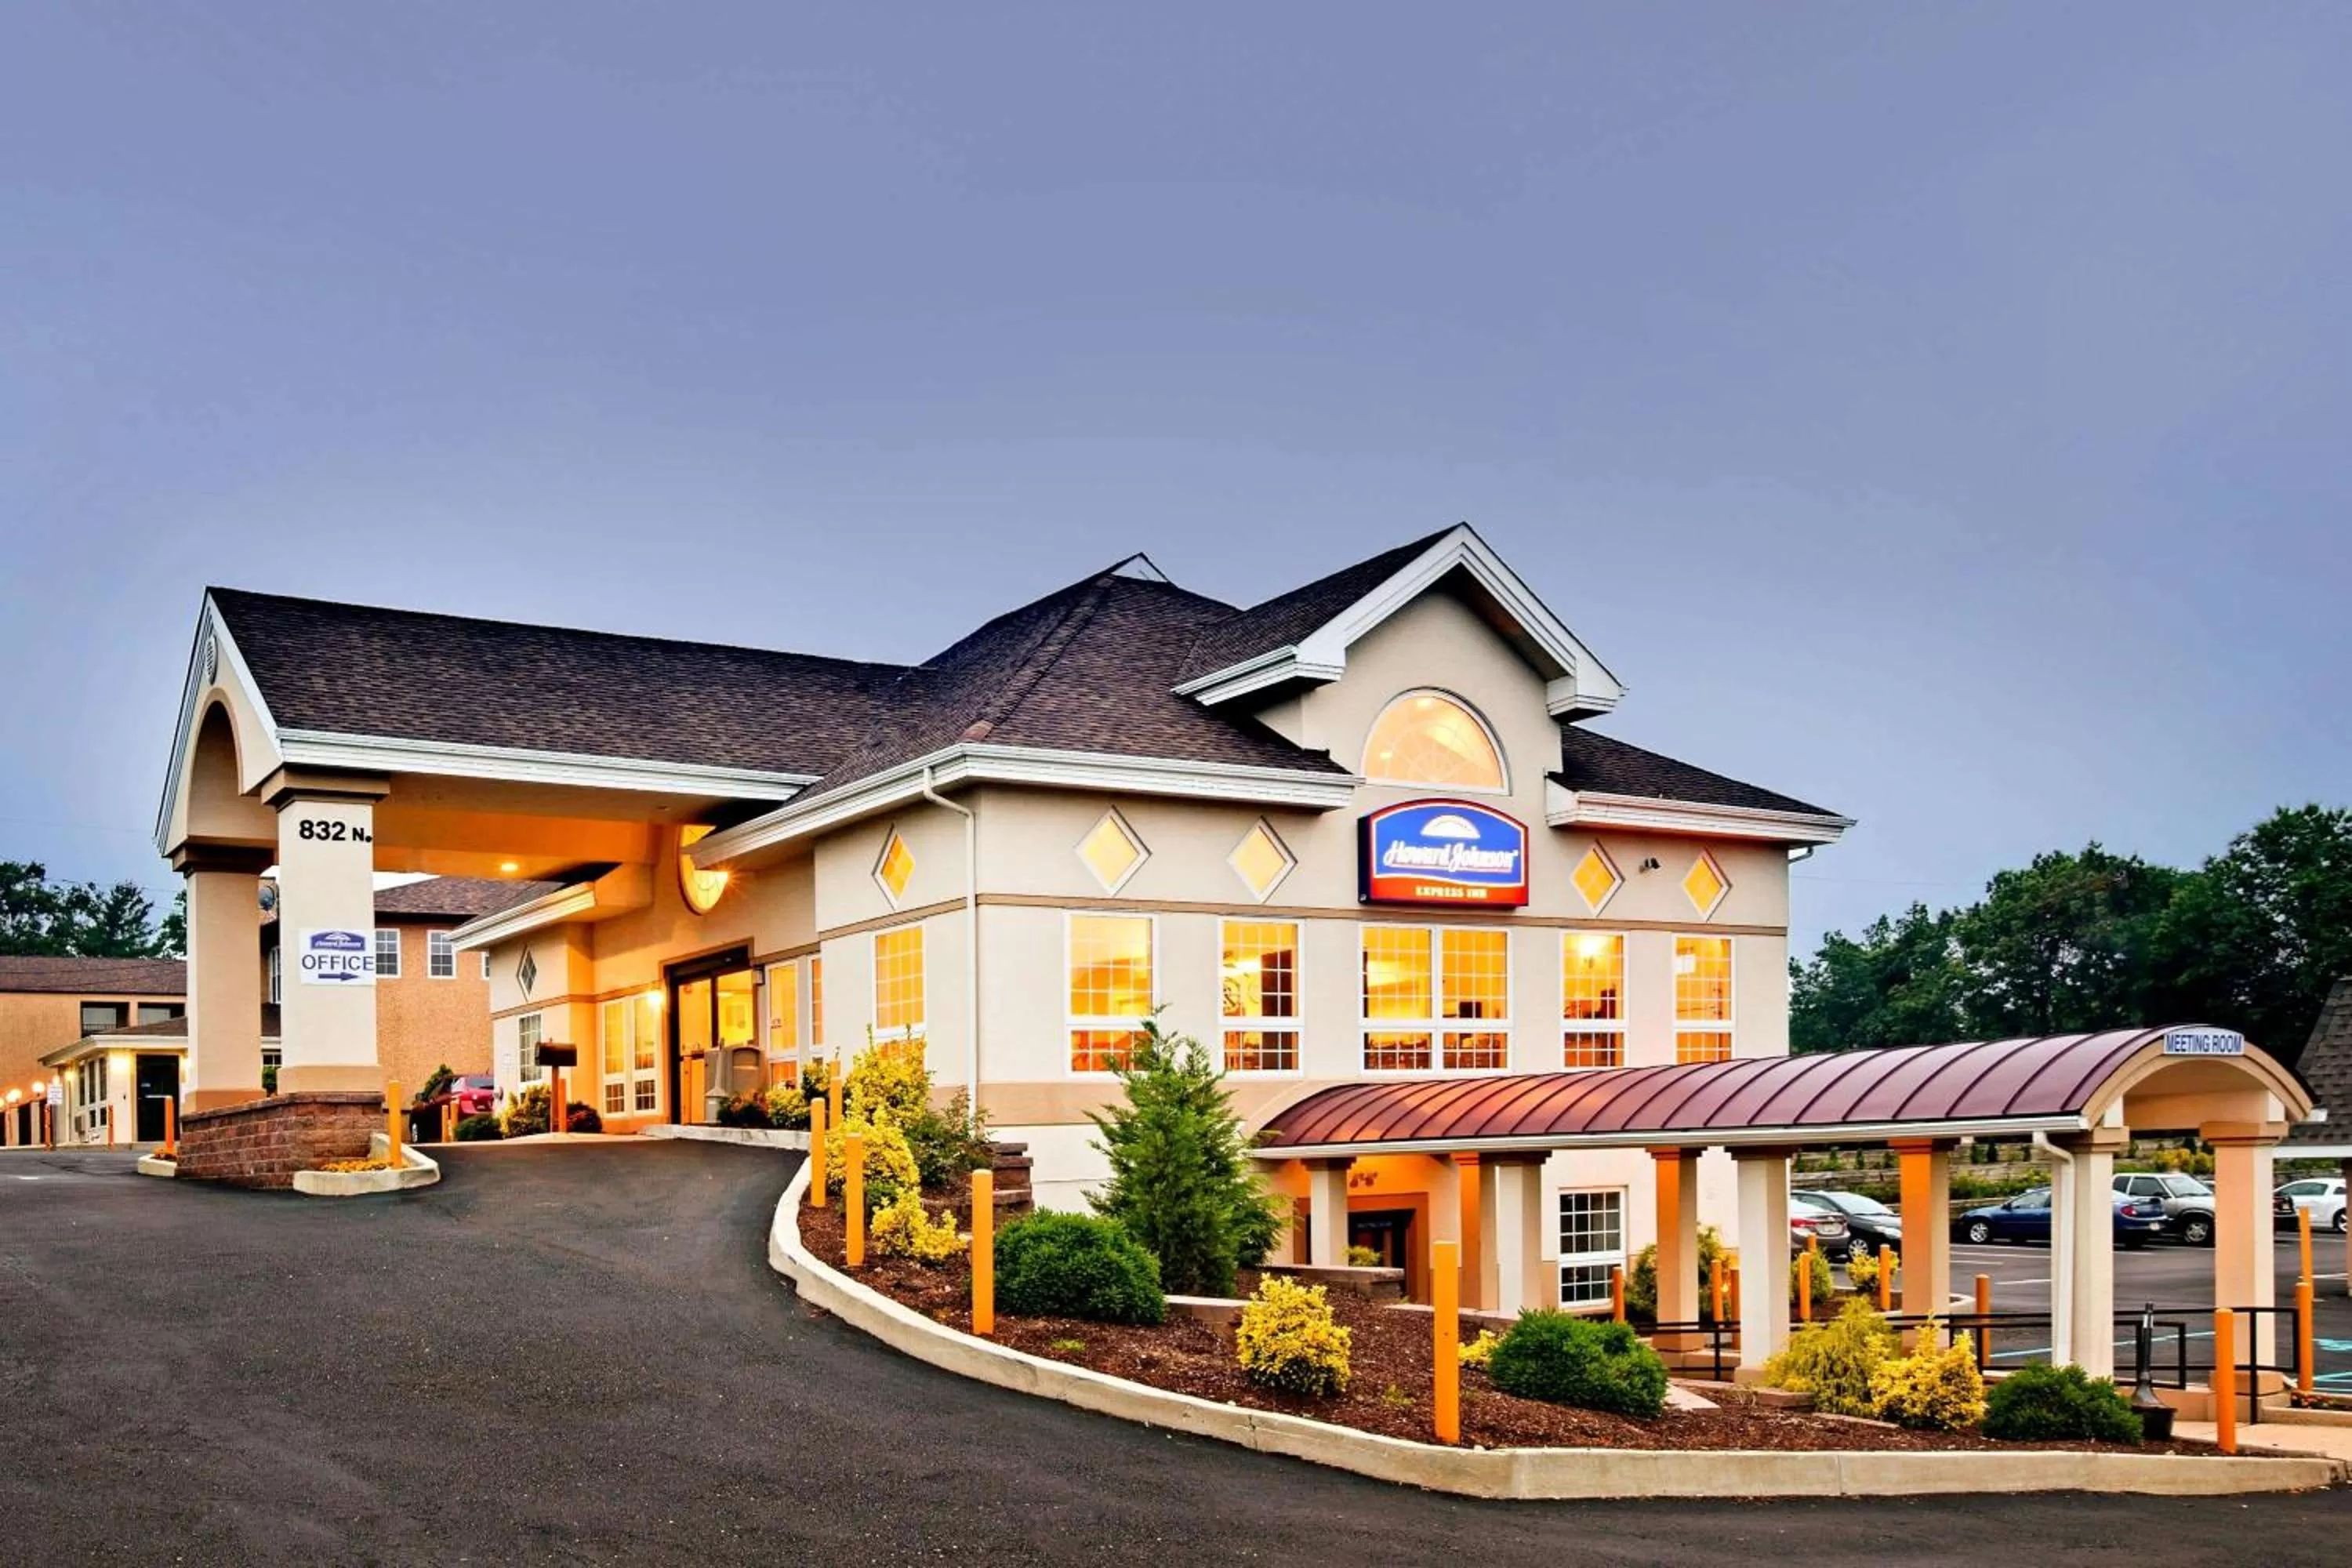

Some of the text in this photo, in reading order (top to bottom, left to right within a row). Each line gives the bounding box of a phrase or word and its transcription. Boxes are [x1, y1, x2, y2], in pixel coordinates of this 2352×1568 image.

[299, 819, 373, 843] 832 N.
[1382, 840, 1452, 867] Howard
[1415, 886, 1487, 898] EXPRESS INN
[301, 954, 375, 971] OFFICE
[2166, 1034, 2242, 1052] MEETING ROOM
